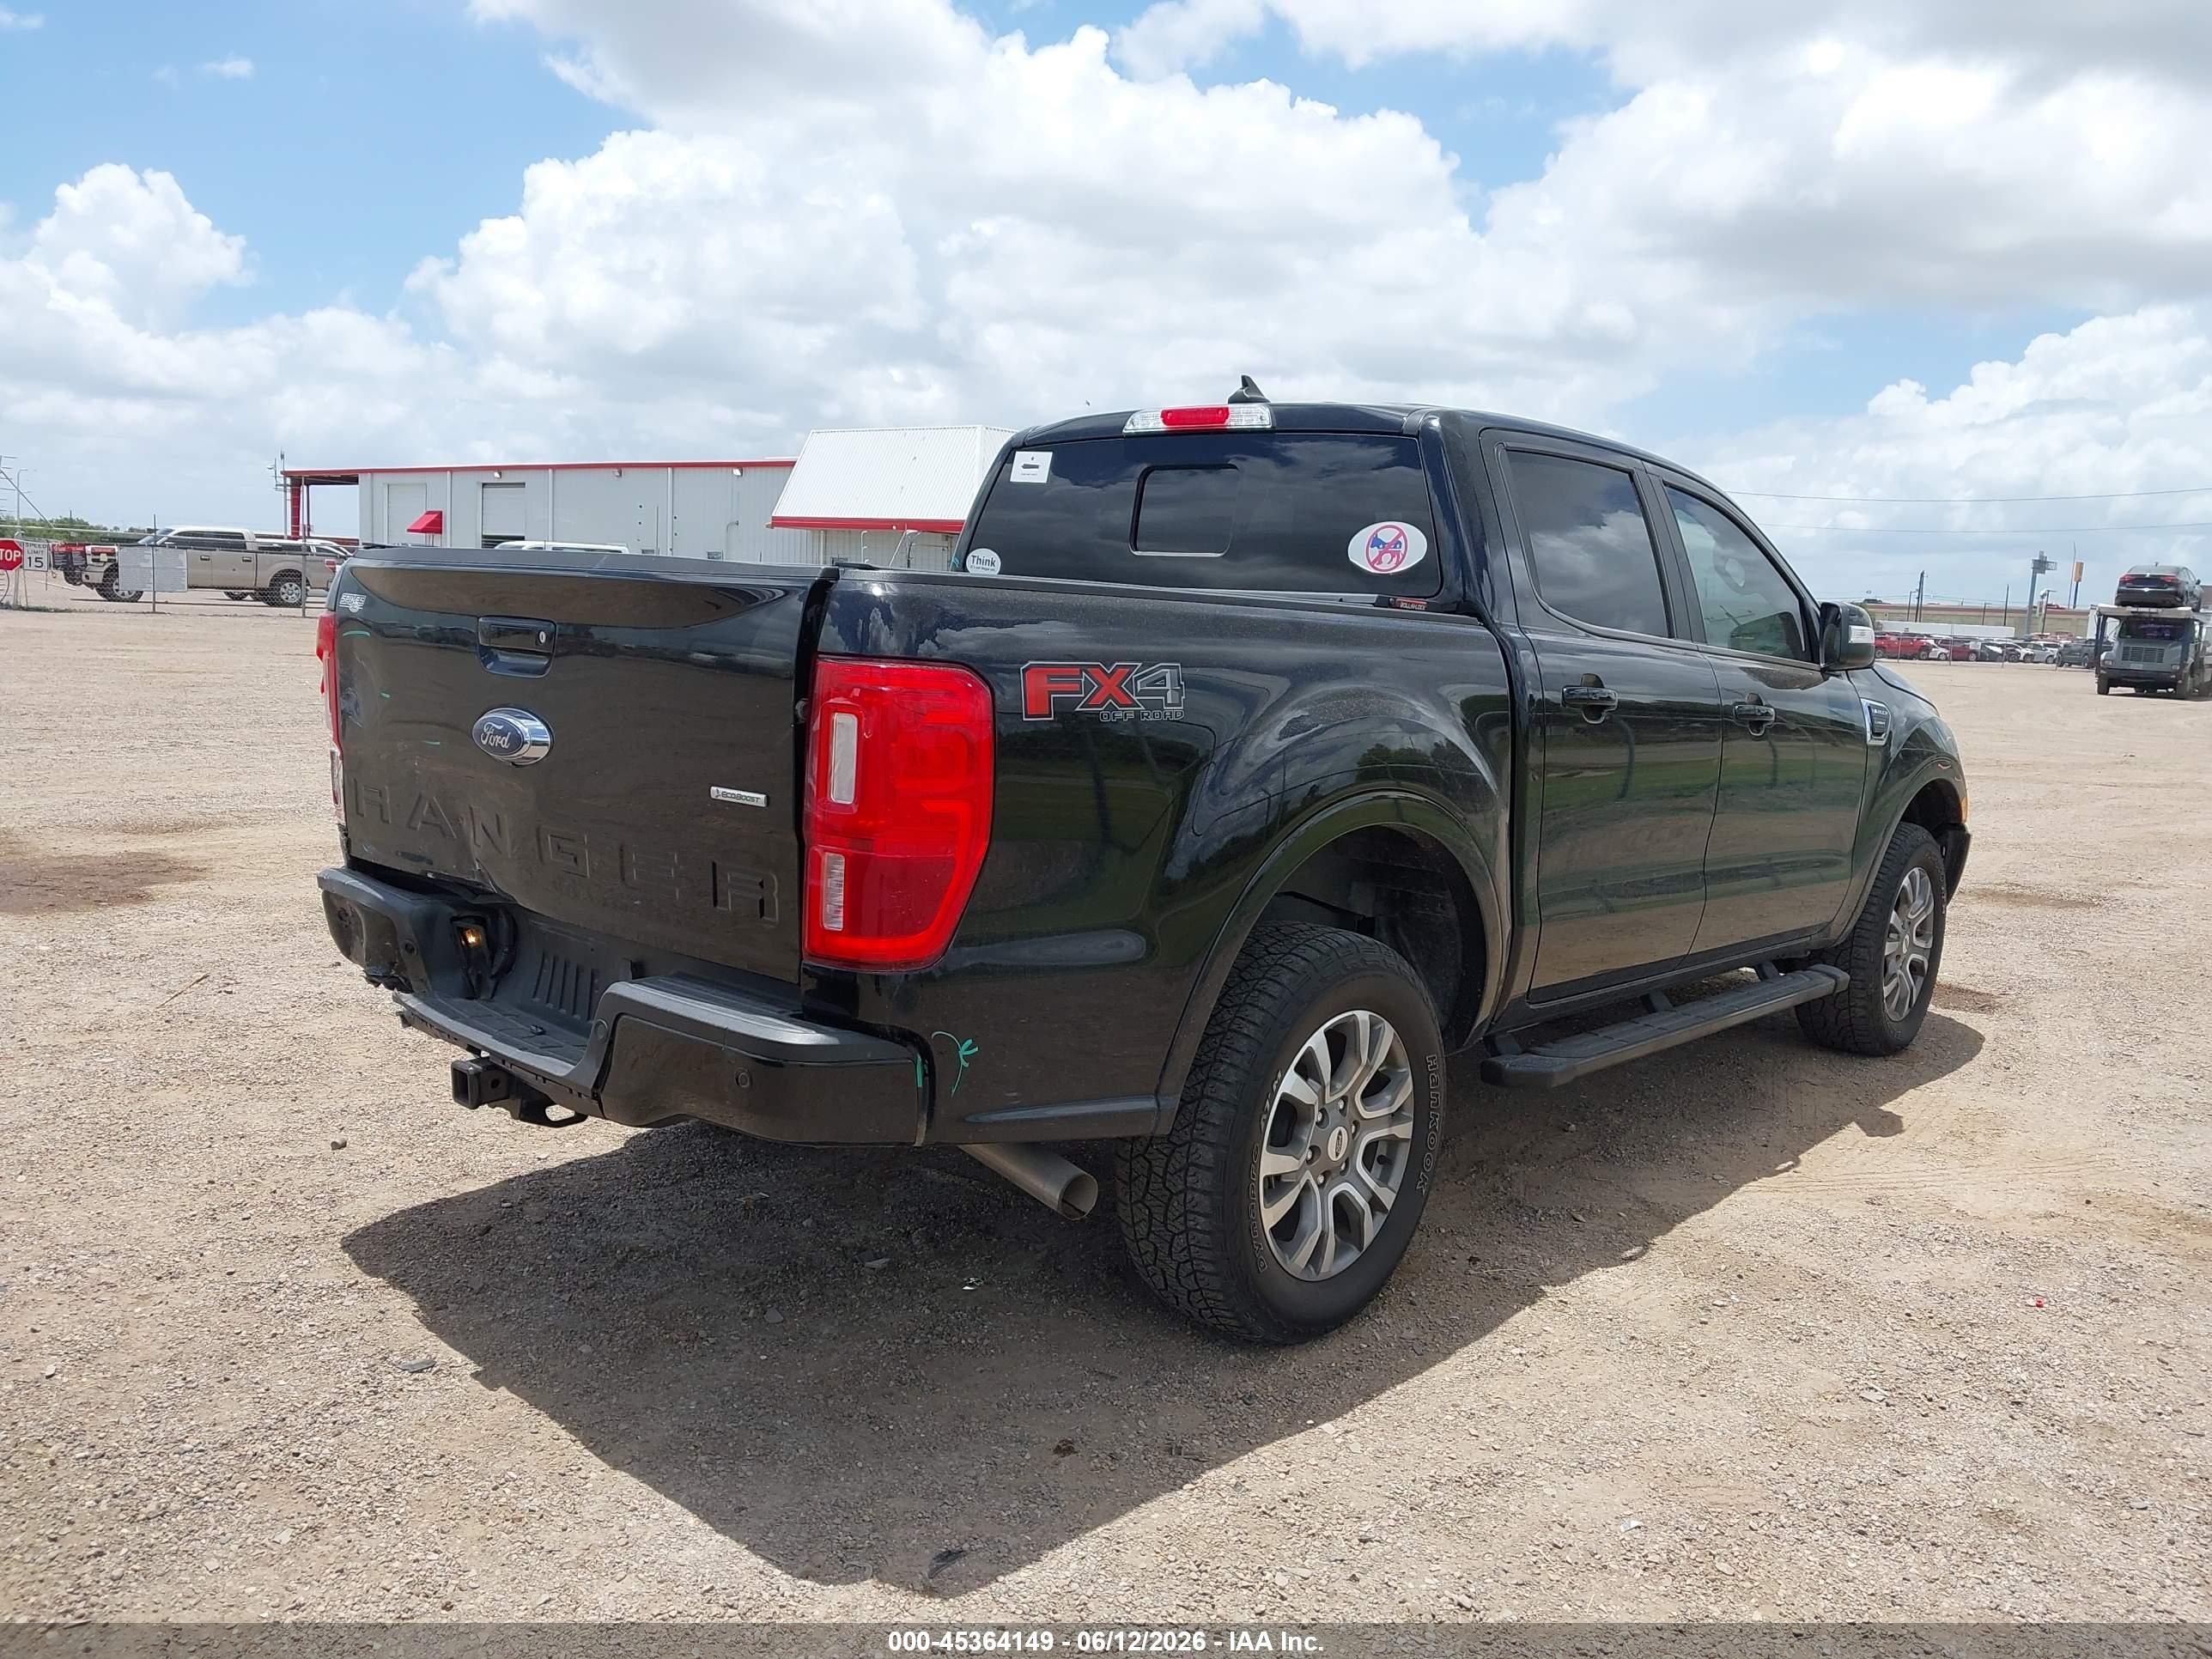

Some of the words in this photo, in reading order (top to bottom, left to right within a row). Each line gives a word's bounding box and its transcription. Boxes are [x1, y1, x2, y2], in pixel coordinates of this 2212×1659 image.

[0, 548, 21, 562] TOP
[27, 556, 44, 568] 15
[970, 555, 996, 568] Think
[1019, 660, 1186, 721] FX4
[1099, 711, 1135, 722] OFF
[1140, 709, 1184, 721] ROAD
[480, 721, 512, 749] Ford
[353, 776, 780, 926] RANGER
